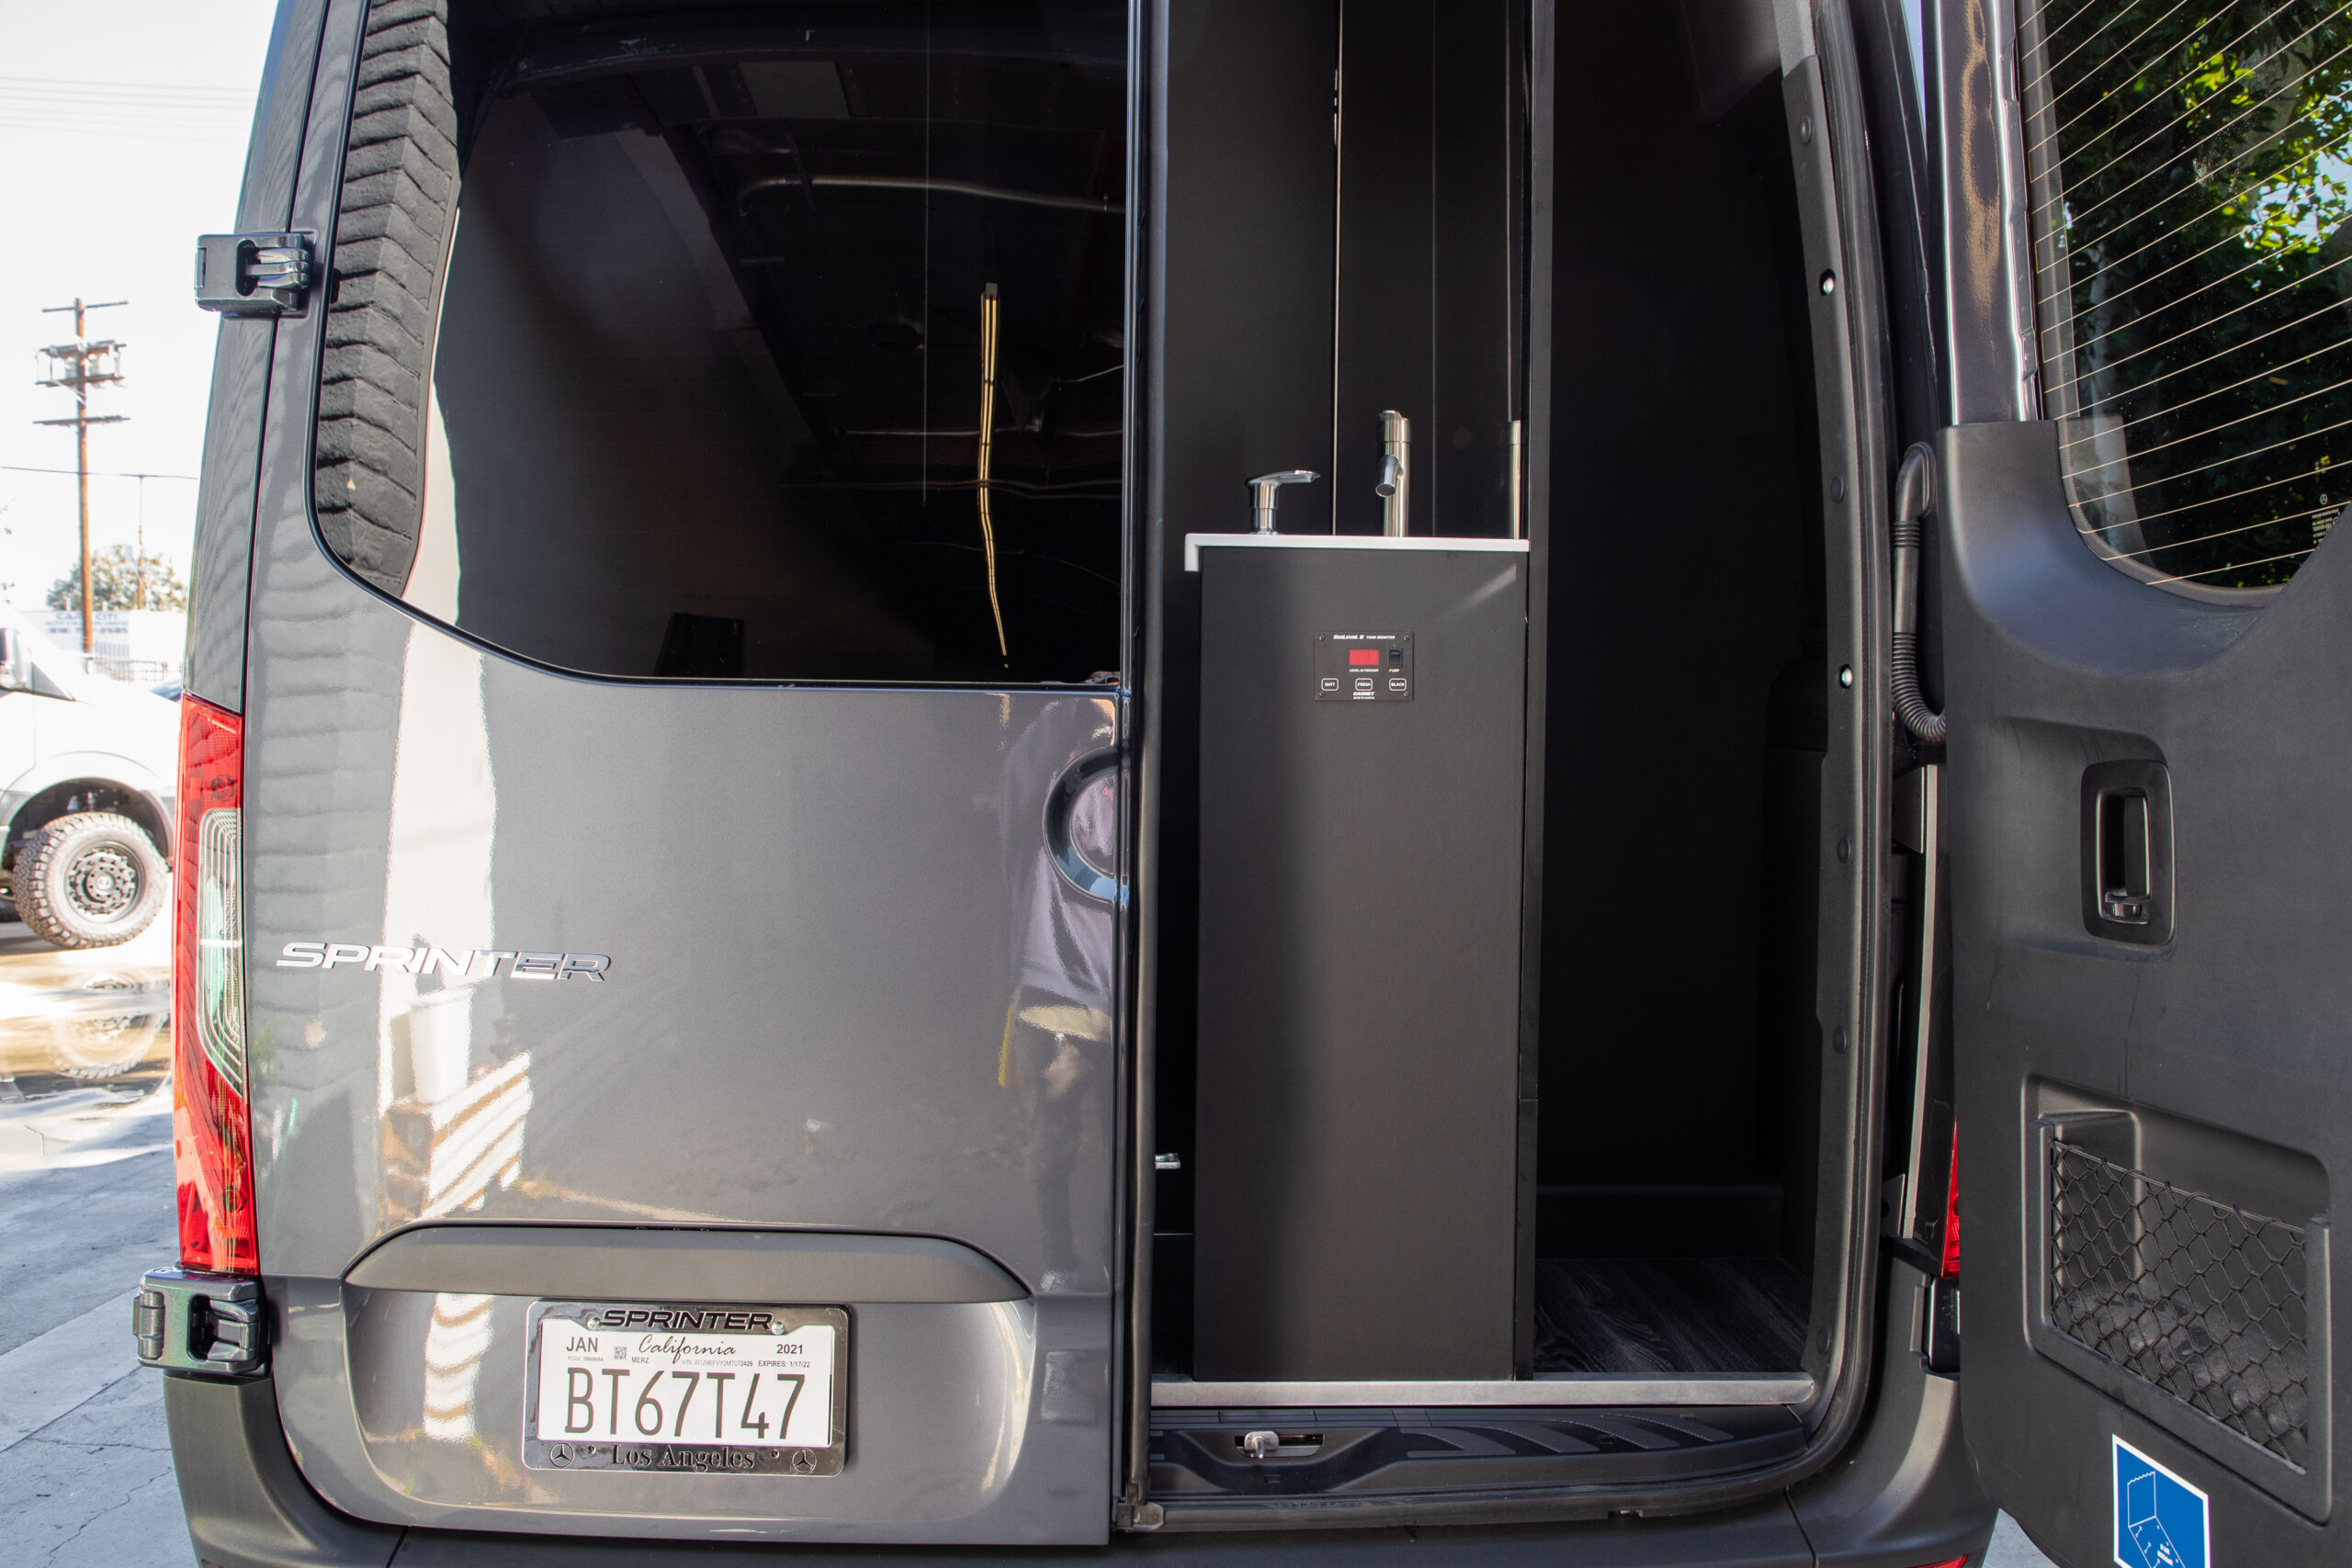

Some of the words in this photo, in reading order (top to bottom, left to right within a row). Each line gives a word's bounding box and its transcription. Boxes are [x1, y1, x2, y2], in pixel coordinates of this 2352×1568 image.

[276, 942, 612, 981] SPRINTER
[600, 1310, 774, 1330] SPRINTER
[566, 1337, 599, 1353] JAN
[639, 1334, 736, 1364] California
[776, 1344, 804, 1355] 2021
[631, 1356, 650, 1364] MERZ
[758, 1359, 788, 1368] EXPIRES:
[789, 1360, 810, 1369] 1/17/22
[565, 1367, 806, 1439] BT67T47
[611, 1444, 652, 1466] Los
[660, 1446, 755, 1471] Angeles
